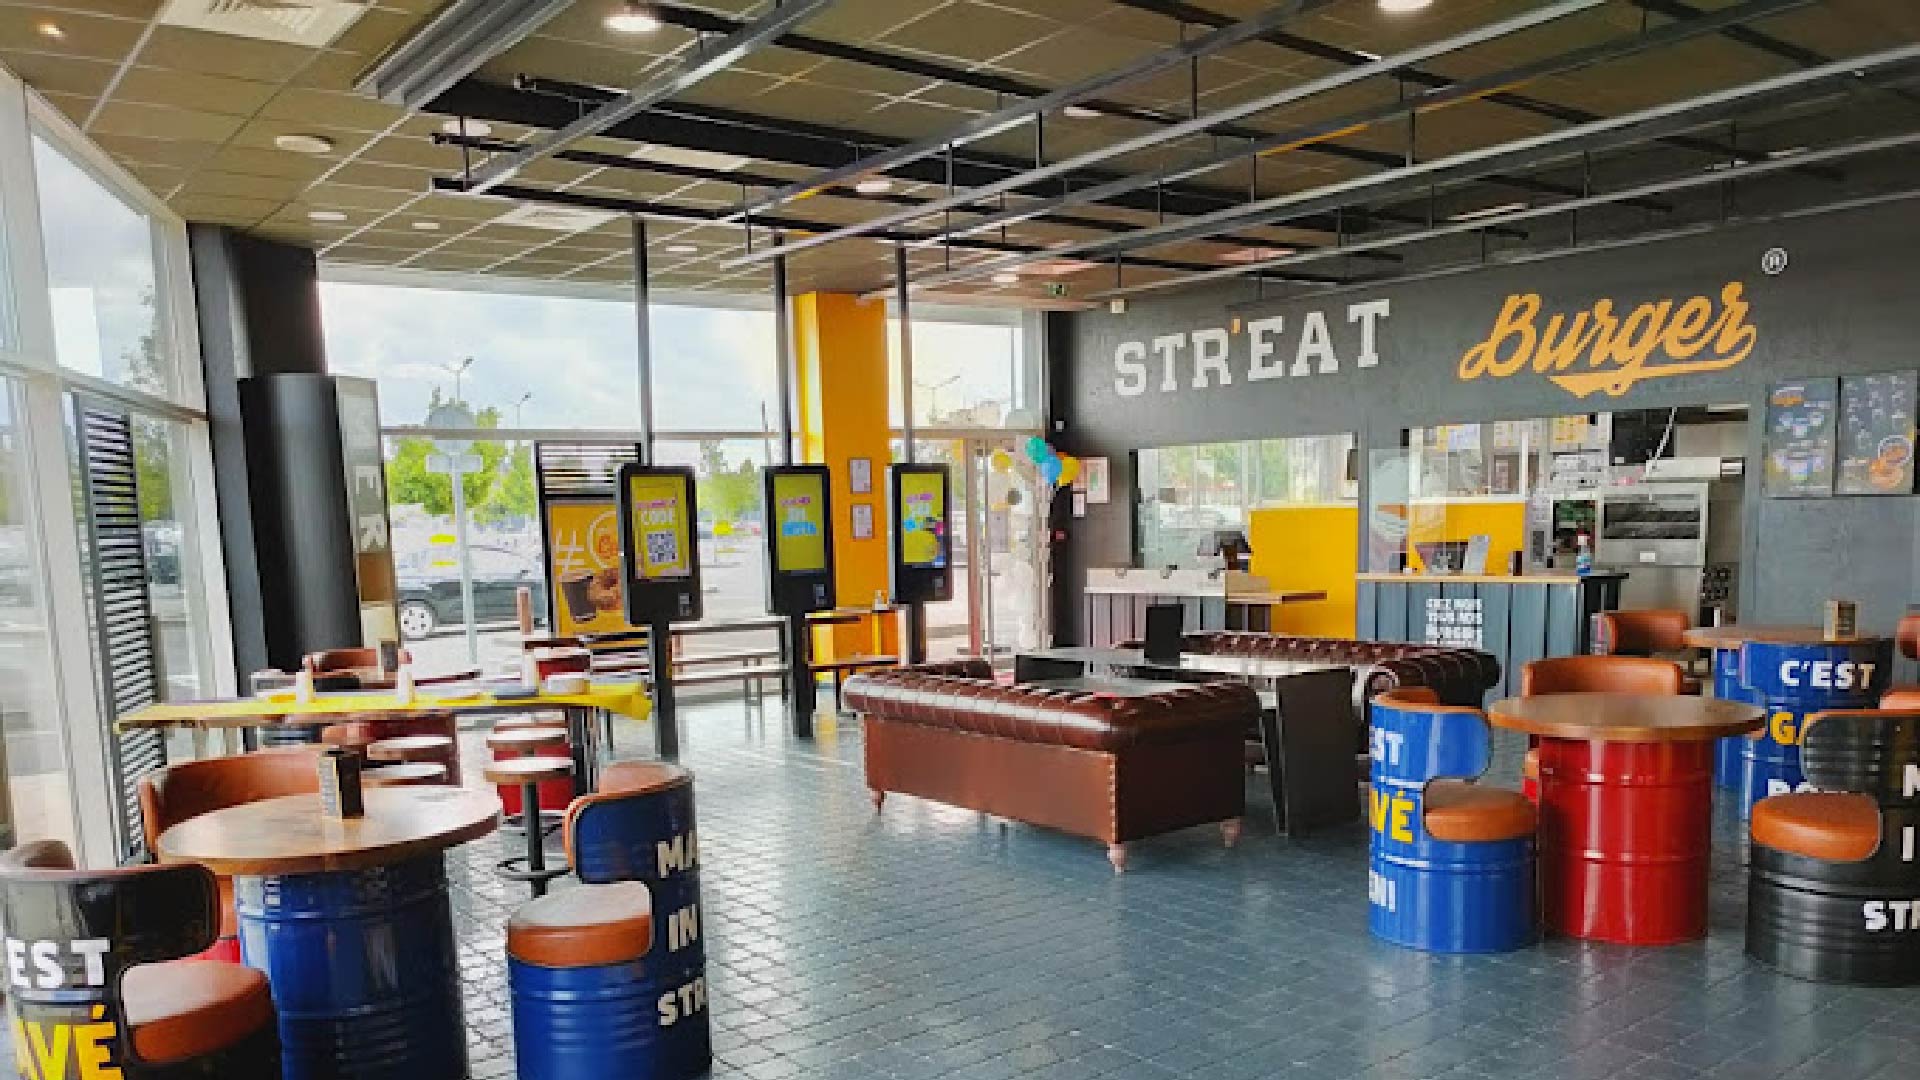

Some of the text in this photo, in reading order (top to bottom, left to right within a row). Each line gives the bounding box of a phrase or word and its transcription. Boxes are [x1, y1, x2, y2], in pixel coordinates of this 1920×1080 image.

[1114, 299, 1391, 397] STR'EAT
[1458, 281, 1757, 398] Burger
[1779, 660, 1876, 690] C'EST
[1369, 789, 1415, 844] VÉ
[667, 903, 698, 953] IN
